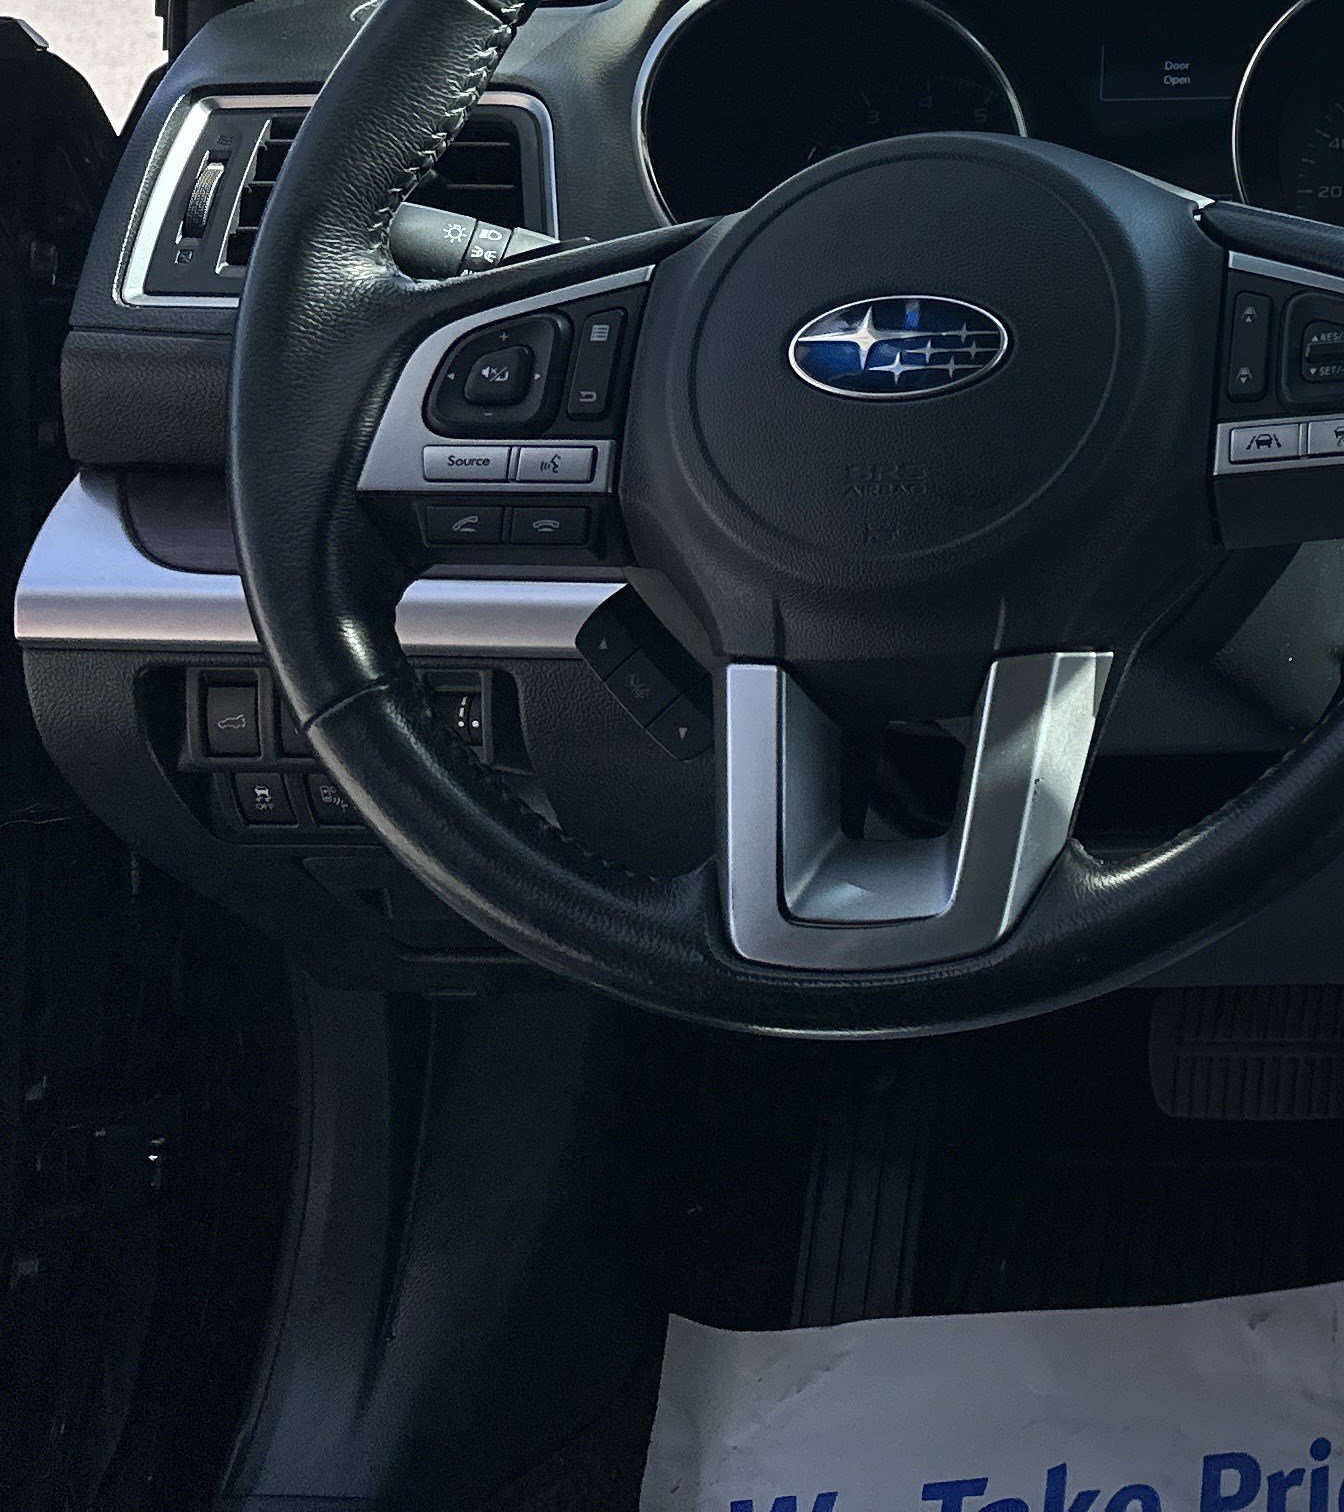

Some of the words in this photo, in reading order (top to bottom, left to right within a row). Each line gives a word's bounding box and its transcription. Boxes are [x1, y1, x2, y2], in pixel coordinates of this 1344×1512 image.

[1164, 60, 1190, 71] Door
[1164, 74, 1191, 87] Open
[1317, 185, 1343, 199] 20
[447, 455, 490, 467] Source
